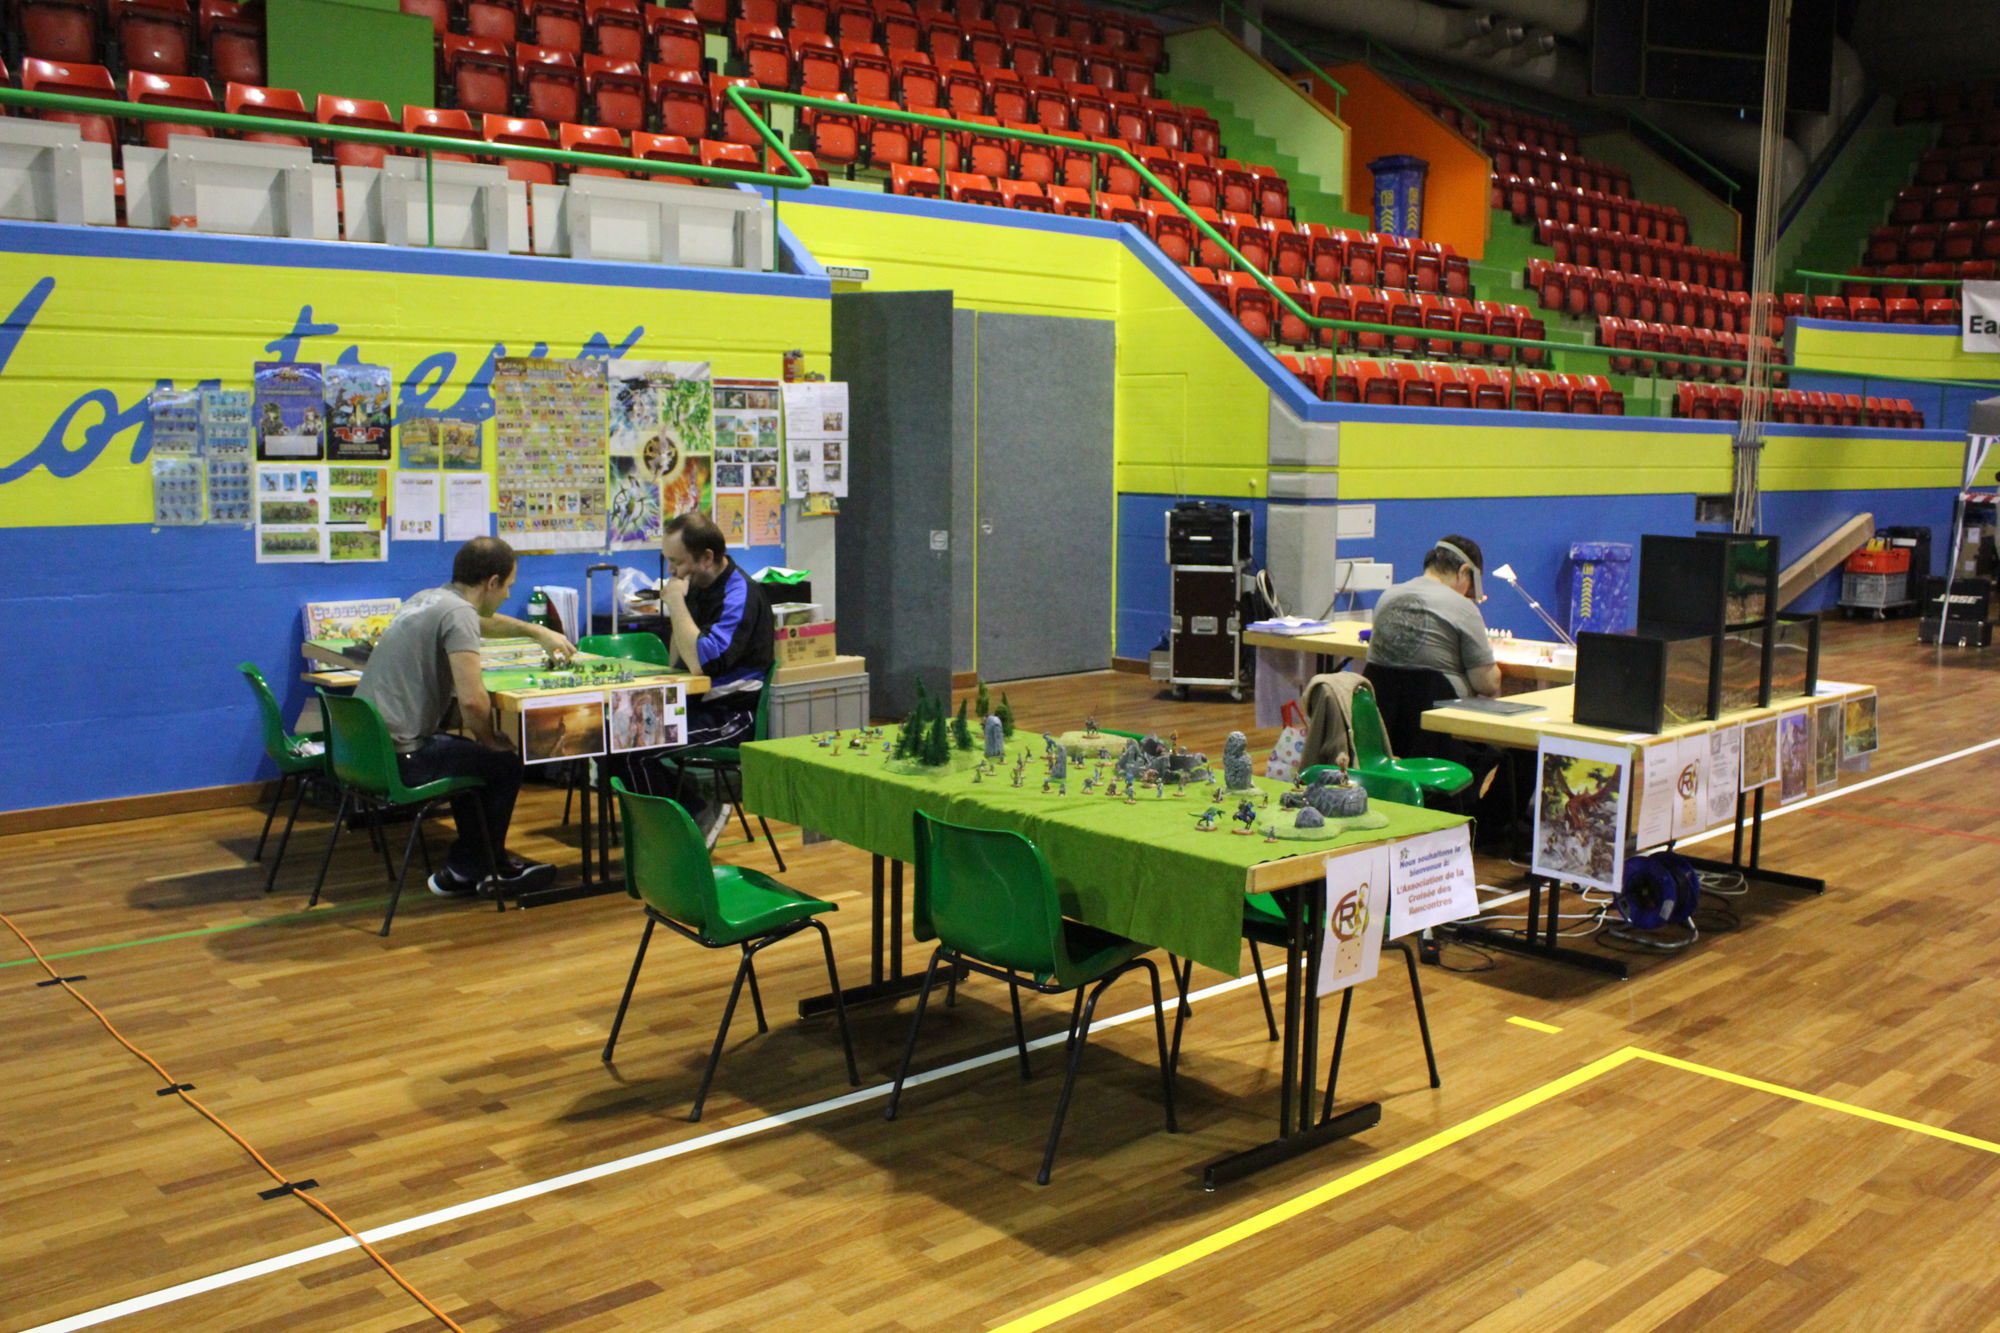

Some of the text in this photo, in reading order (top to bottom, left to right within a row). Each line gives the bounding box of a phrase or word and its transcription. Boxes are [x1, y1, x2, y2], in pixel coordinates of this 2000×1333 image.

[1969, 314, 2000, 338] Ea
[1399, 859, 1416, 869] Nous
[1396, 868, 1464, 895] L'Association de la
[1408, 885, 1452, 903] Croisée des
[1408, 898, 1453, 915] Rencontres
